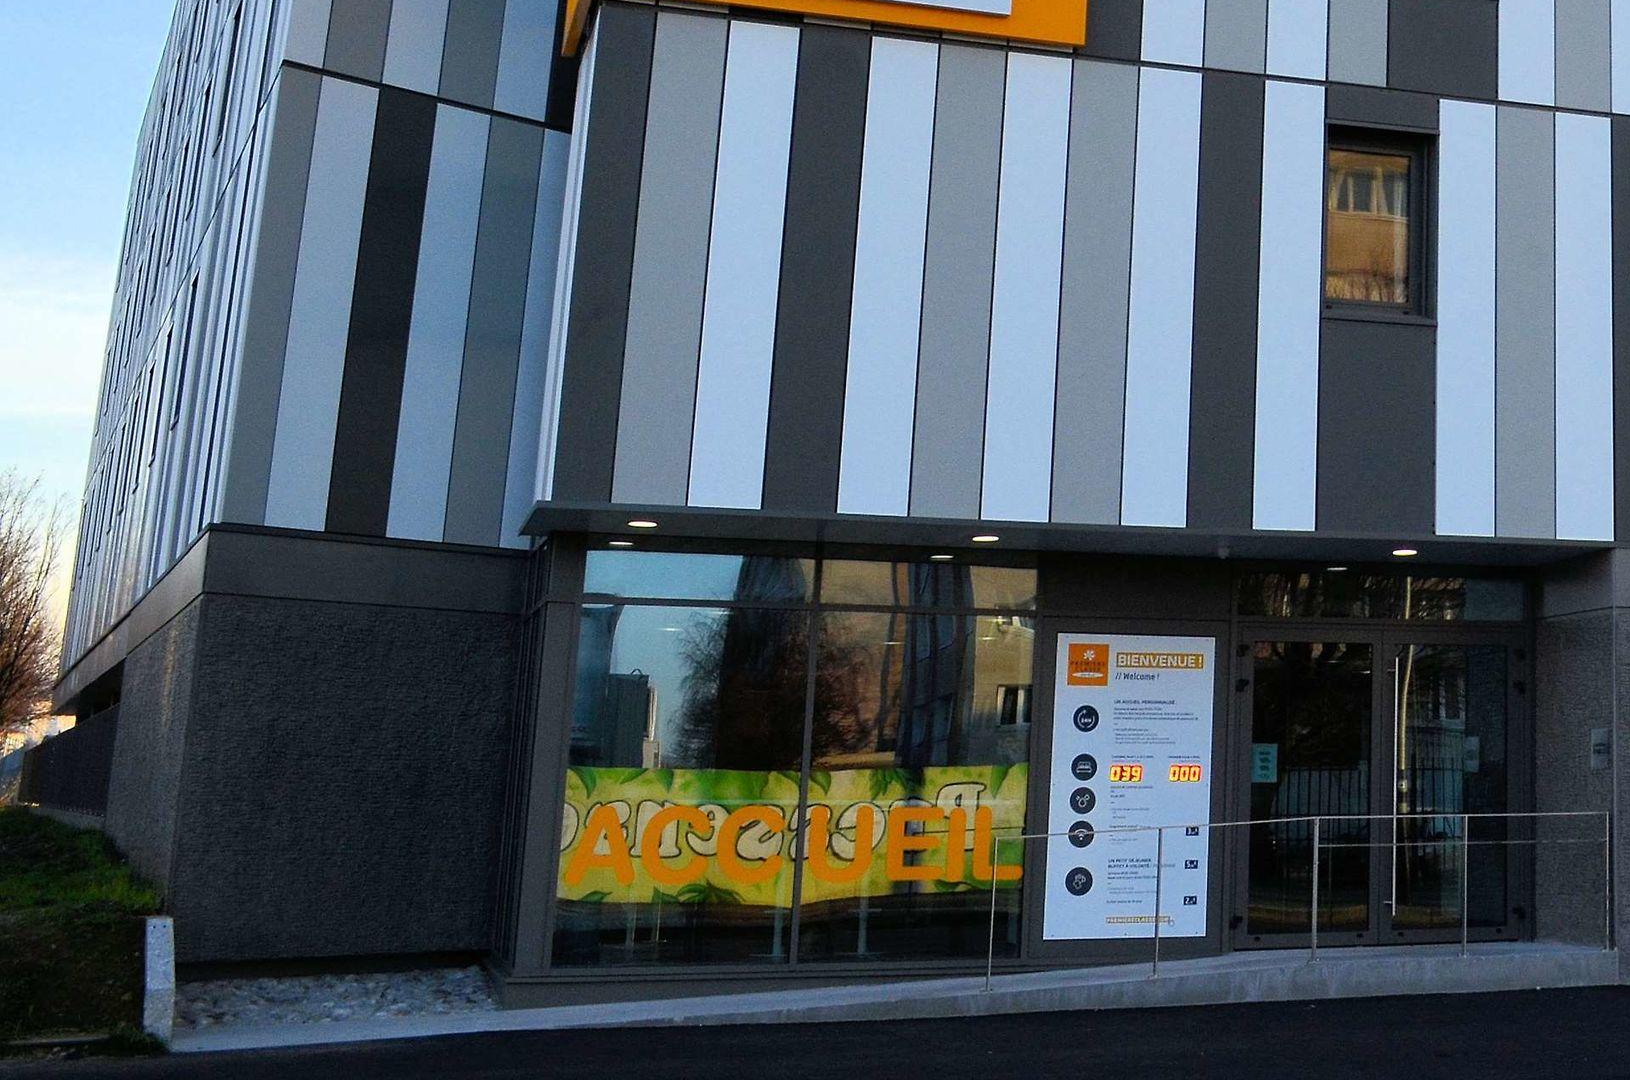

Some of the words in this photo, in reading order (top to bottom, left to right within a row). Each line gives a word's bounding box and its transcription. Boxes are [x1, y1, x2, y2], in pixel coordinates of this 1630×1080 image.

[1117, 654, 1196, 668] BIENVENUE
[1110, 764, 1142, 782] 039
[1169, 764, 1201, 782] 000
[563, 804, 1024, 887] ACCUEIL
